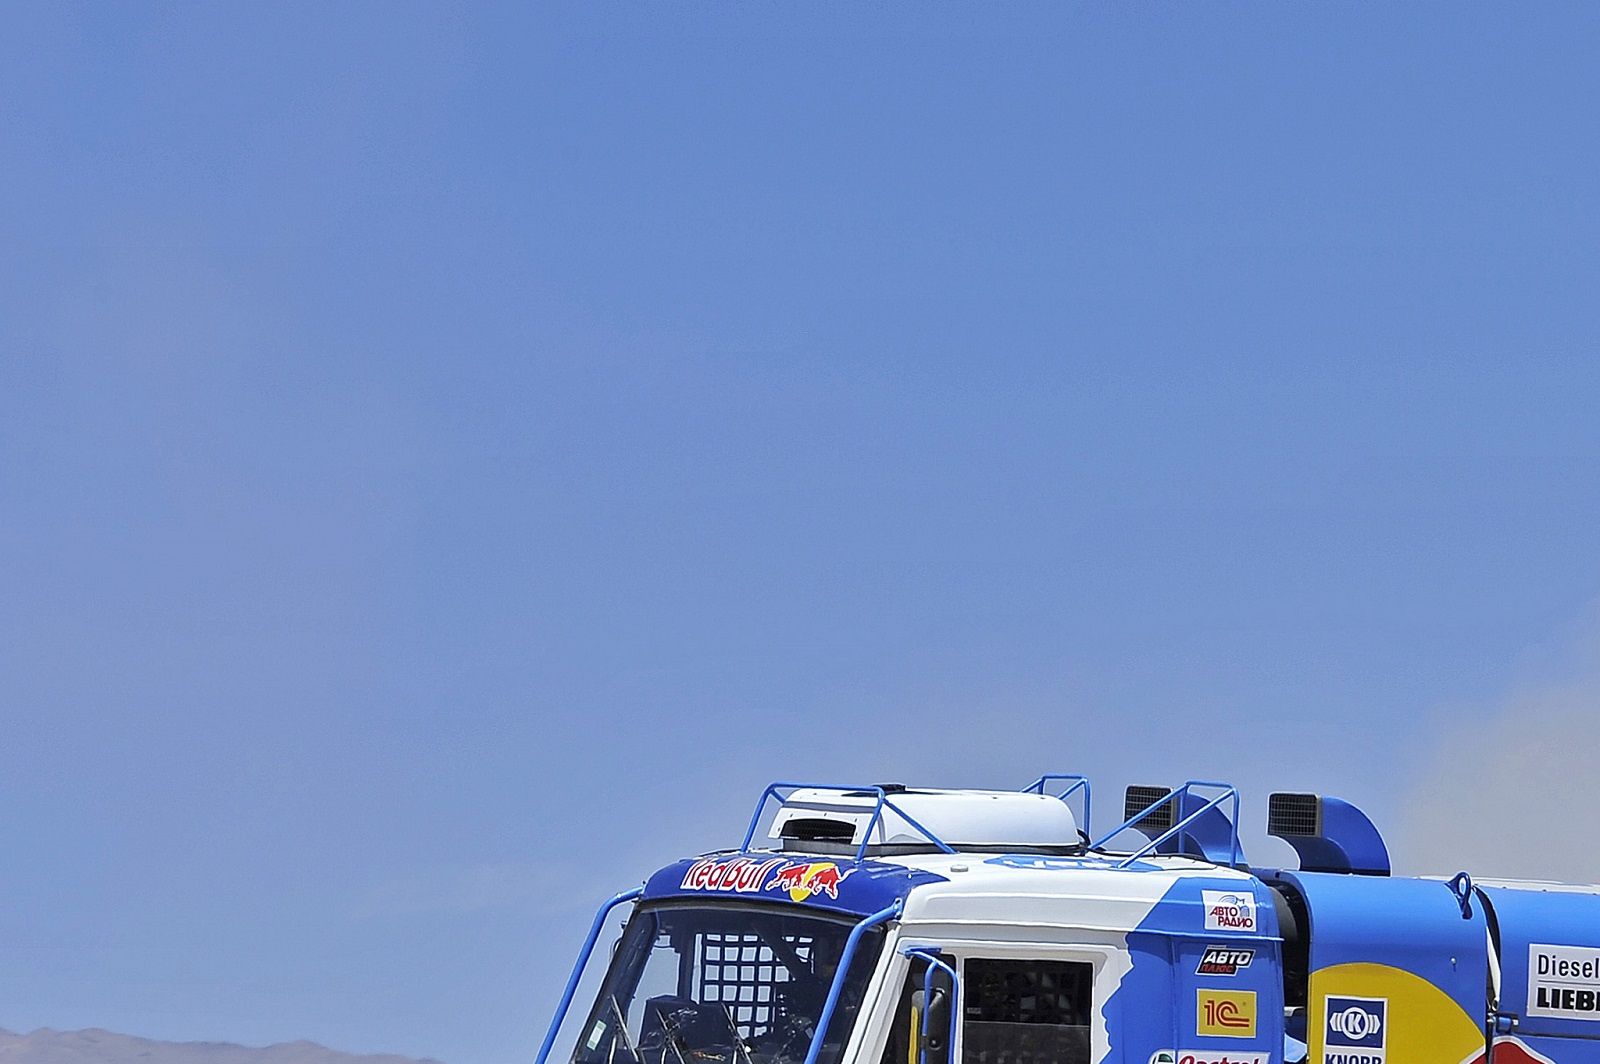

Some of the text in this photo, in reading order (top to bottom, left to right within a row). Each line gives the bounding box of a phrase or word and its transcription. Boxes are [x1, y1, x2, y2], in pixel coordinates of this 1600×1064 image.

[1209, 906, 1238, 917] АВТО
[1217, 916, 1254, 928] РАДИО
[1203, 951, 1251, 965] АВТО
